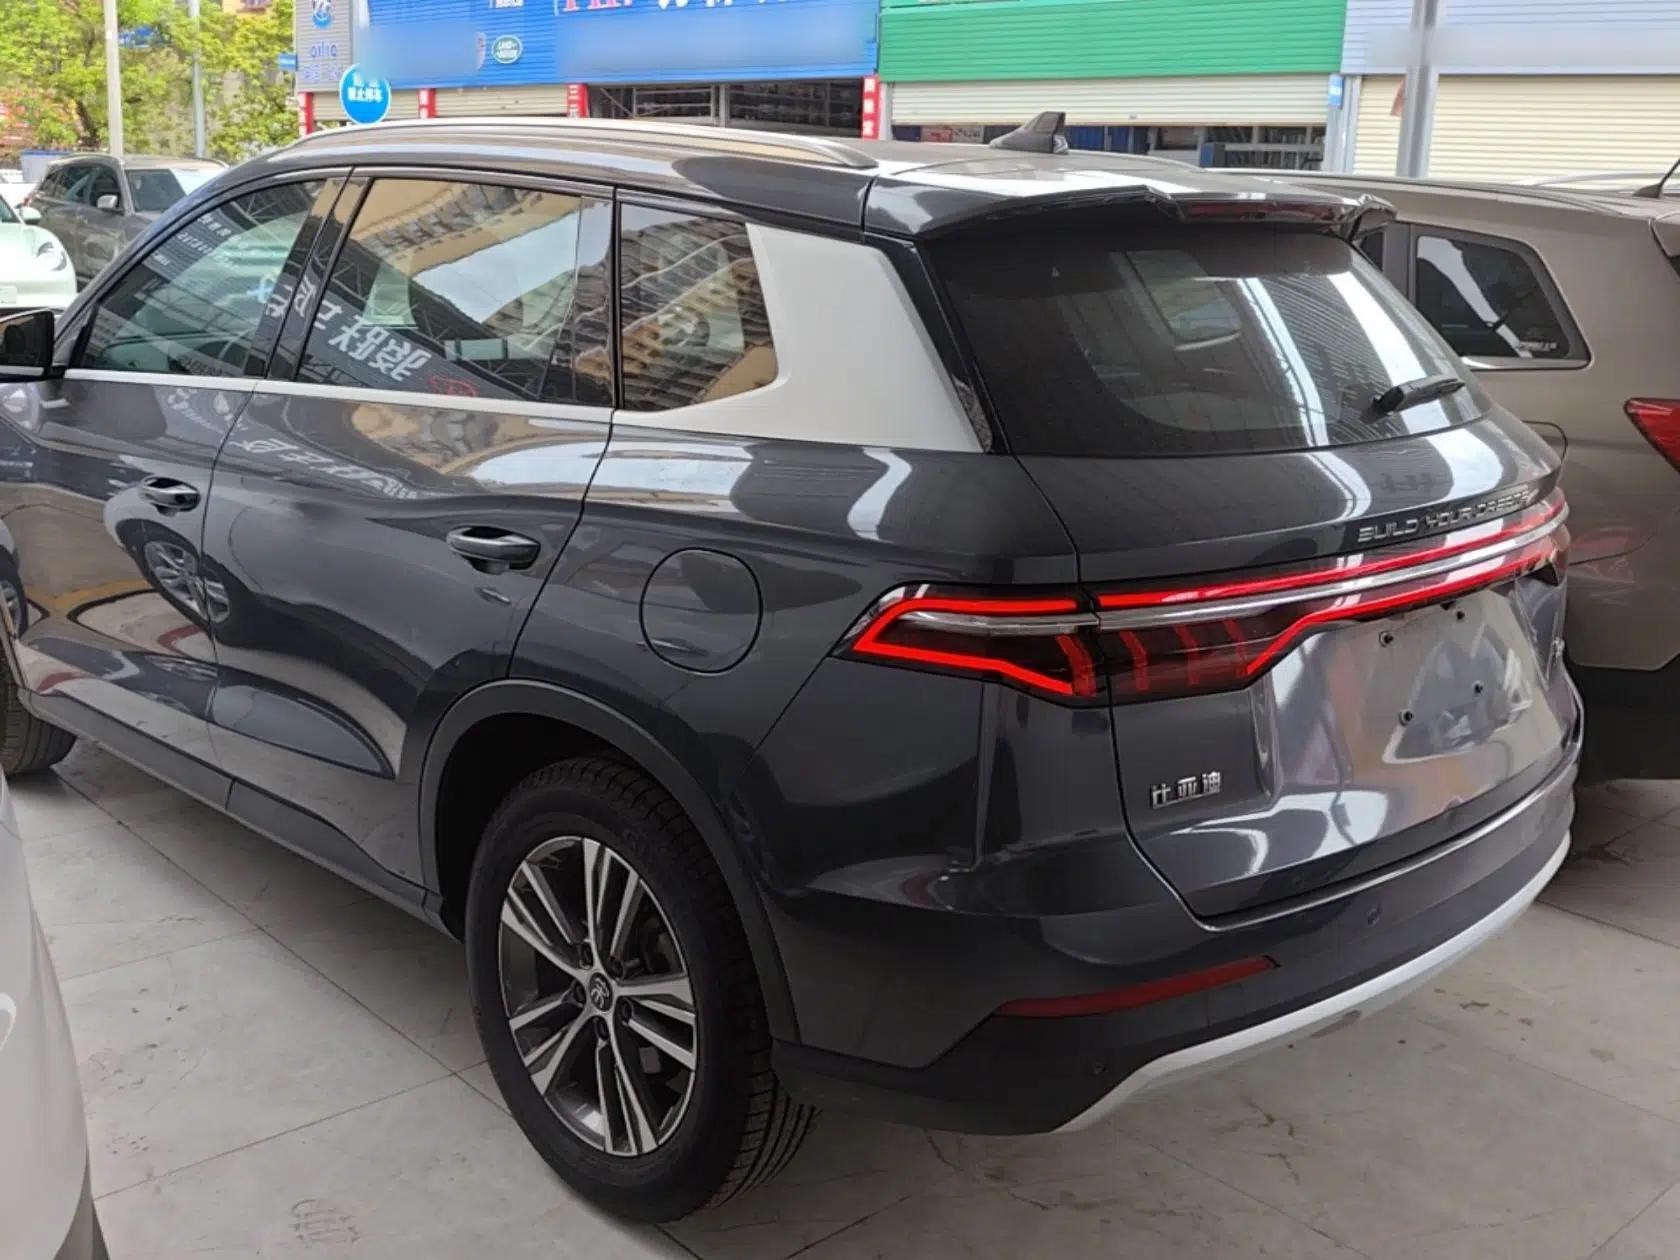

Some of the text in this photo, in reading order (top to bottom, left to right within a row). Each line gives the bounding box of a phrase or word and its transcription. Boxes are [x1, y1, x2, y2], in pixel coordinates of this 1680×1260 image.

[1358, 518, 1418, 543] BUILD
[1424, 506, 1473, 528] YOUR
[1150, 771, 1221, 808] 比亚迪
